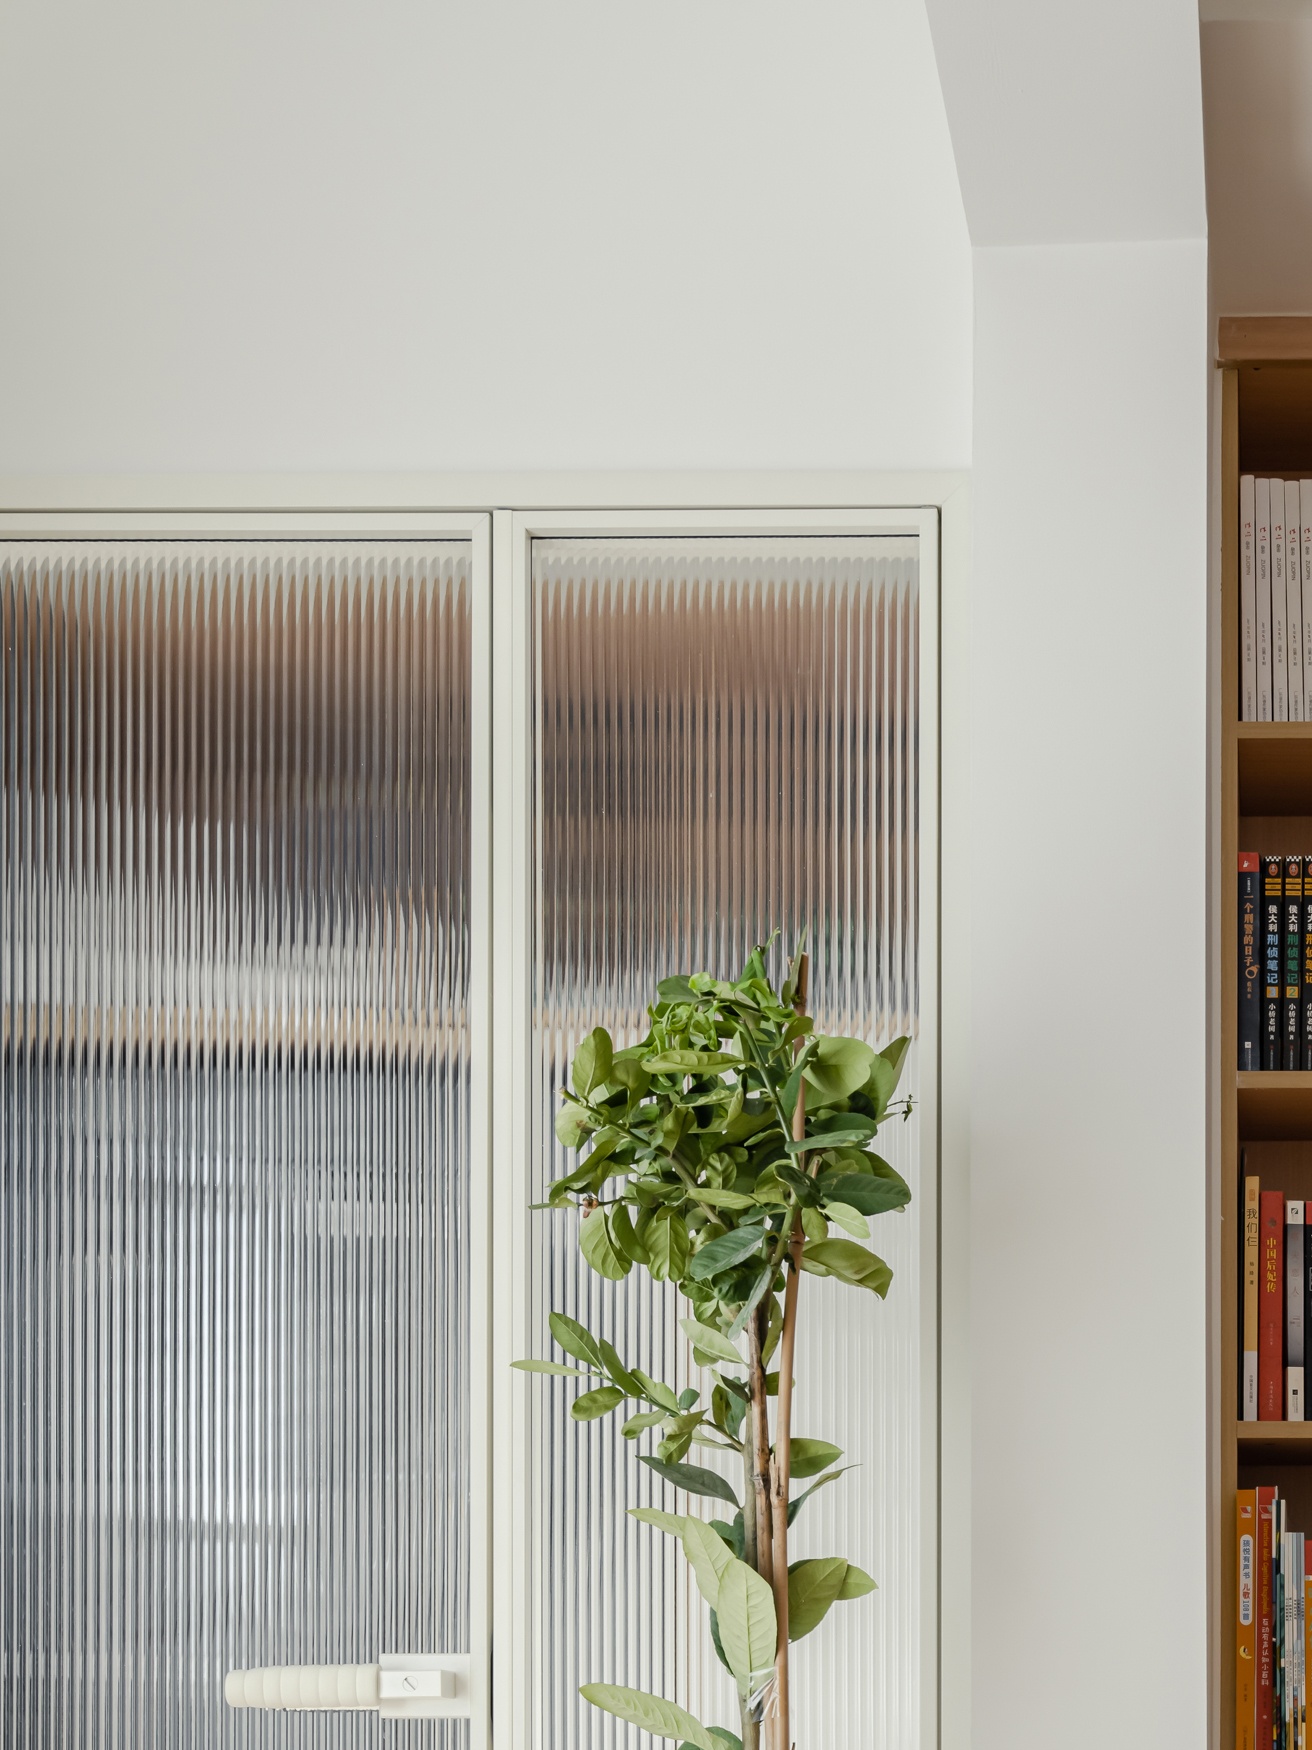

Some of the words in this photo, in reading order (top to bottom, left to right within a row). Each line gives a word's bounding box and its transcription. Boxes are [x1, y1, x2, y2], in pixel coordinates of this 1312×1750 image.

[1246, 1207, 1258, 1247] 我们仨
[1266, 1237, 1277, 1293] 中国后妃传
